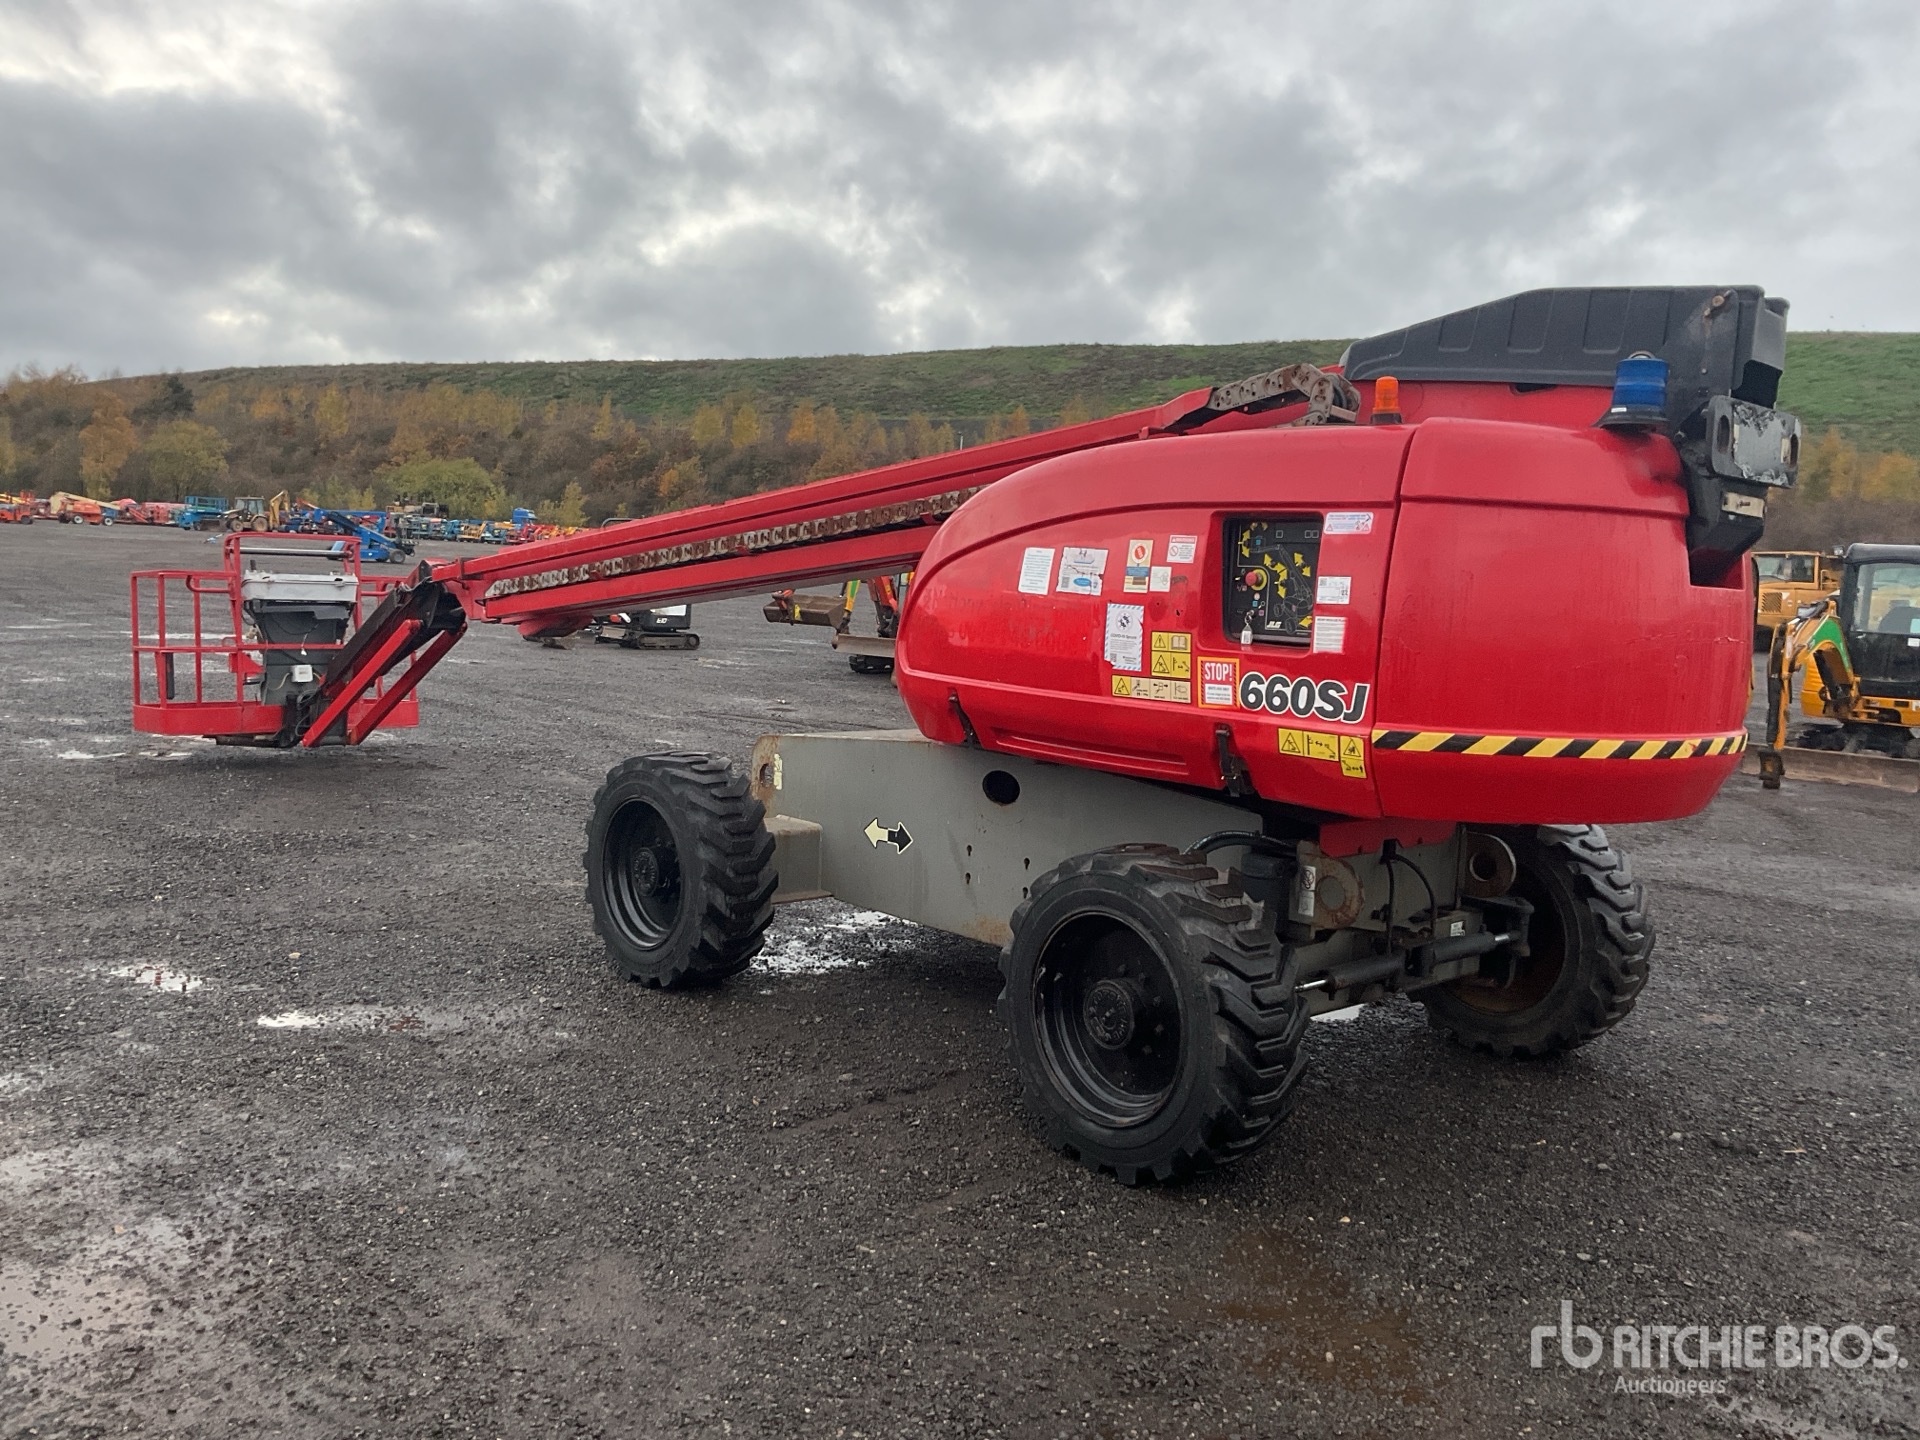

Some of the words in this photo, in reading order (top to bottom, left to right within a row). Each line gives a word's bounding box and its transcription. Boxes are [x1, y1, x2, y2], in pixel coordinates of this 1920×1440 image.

[1266, 620, 1282, 629] JLG
[1204, 662, 1233, 682] STOP!
[1239, 671, 1370, 724] 660SJ
